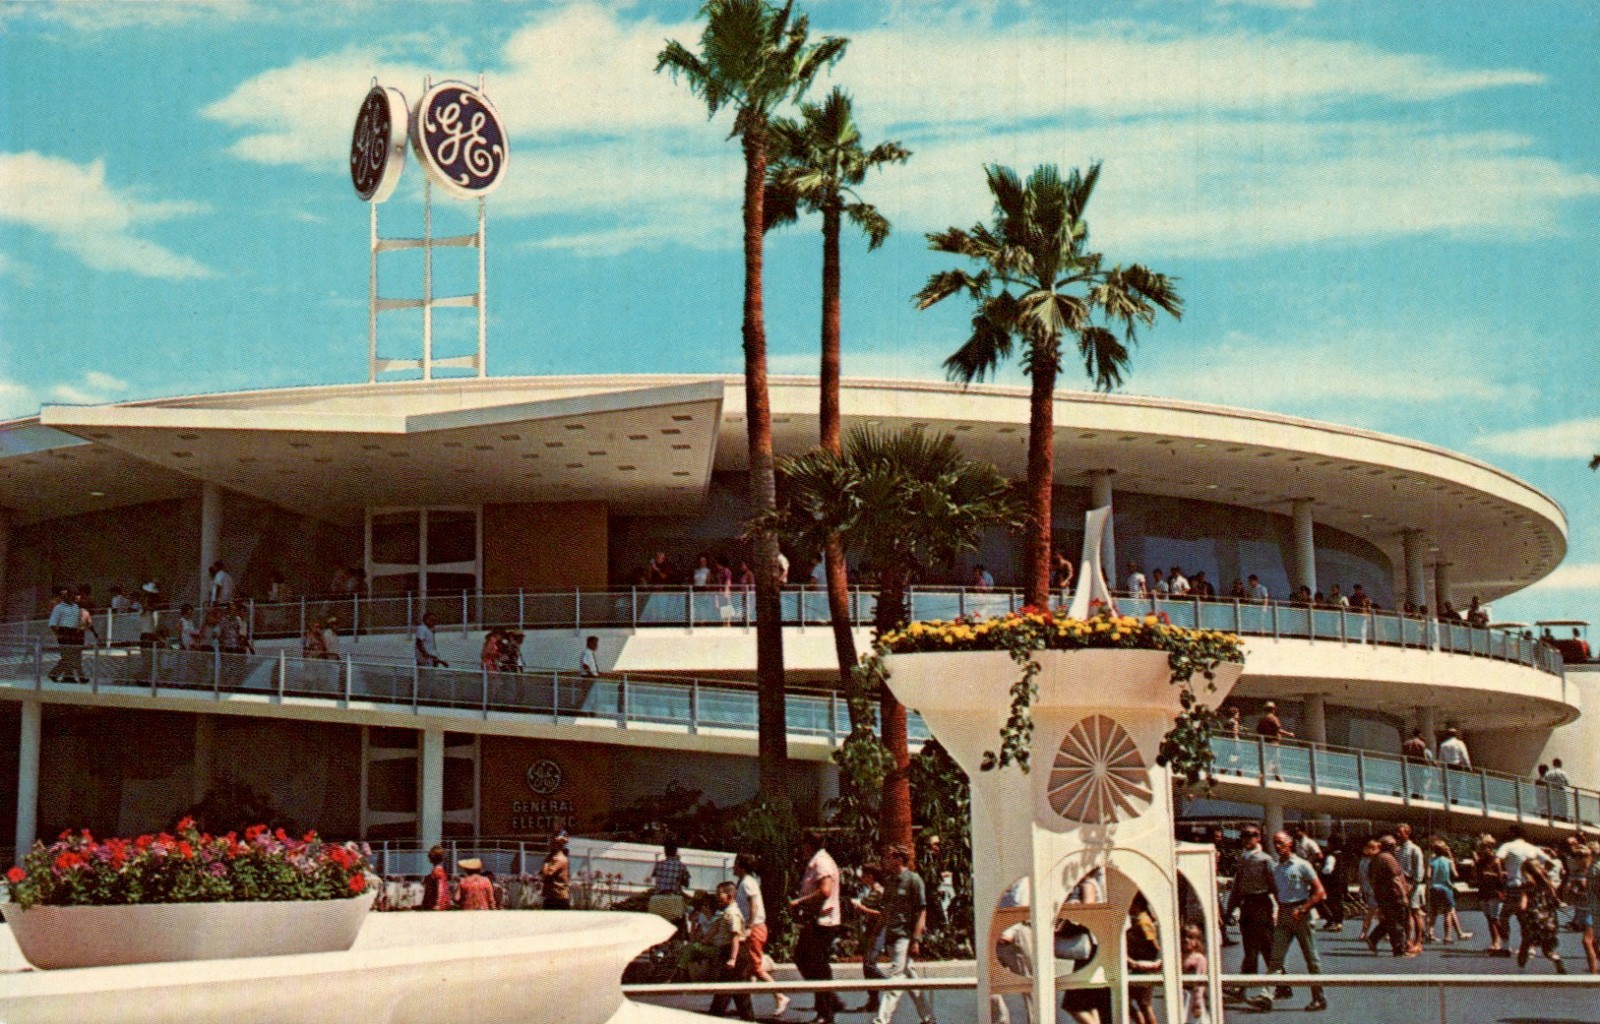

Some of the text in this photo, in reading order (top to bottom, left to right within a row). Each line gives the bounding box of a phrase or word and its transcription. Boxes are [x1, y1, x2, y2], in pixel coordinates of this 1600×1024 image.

[356, 101, 384, 185] GE
[436, 102, 493, 177] GE
[513, 801, 575, 813] GENERAL
